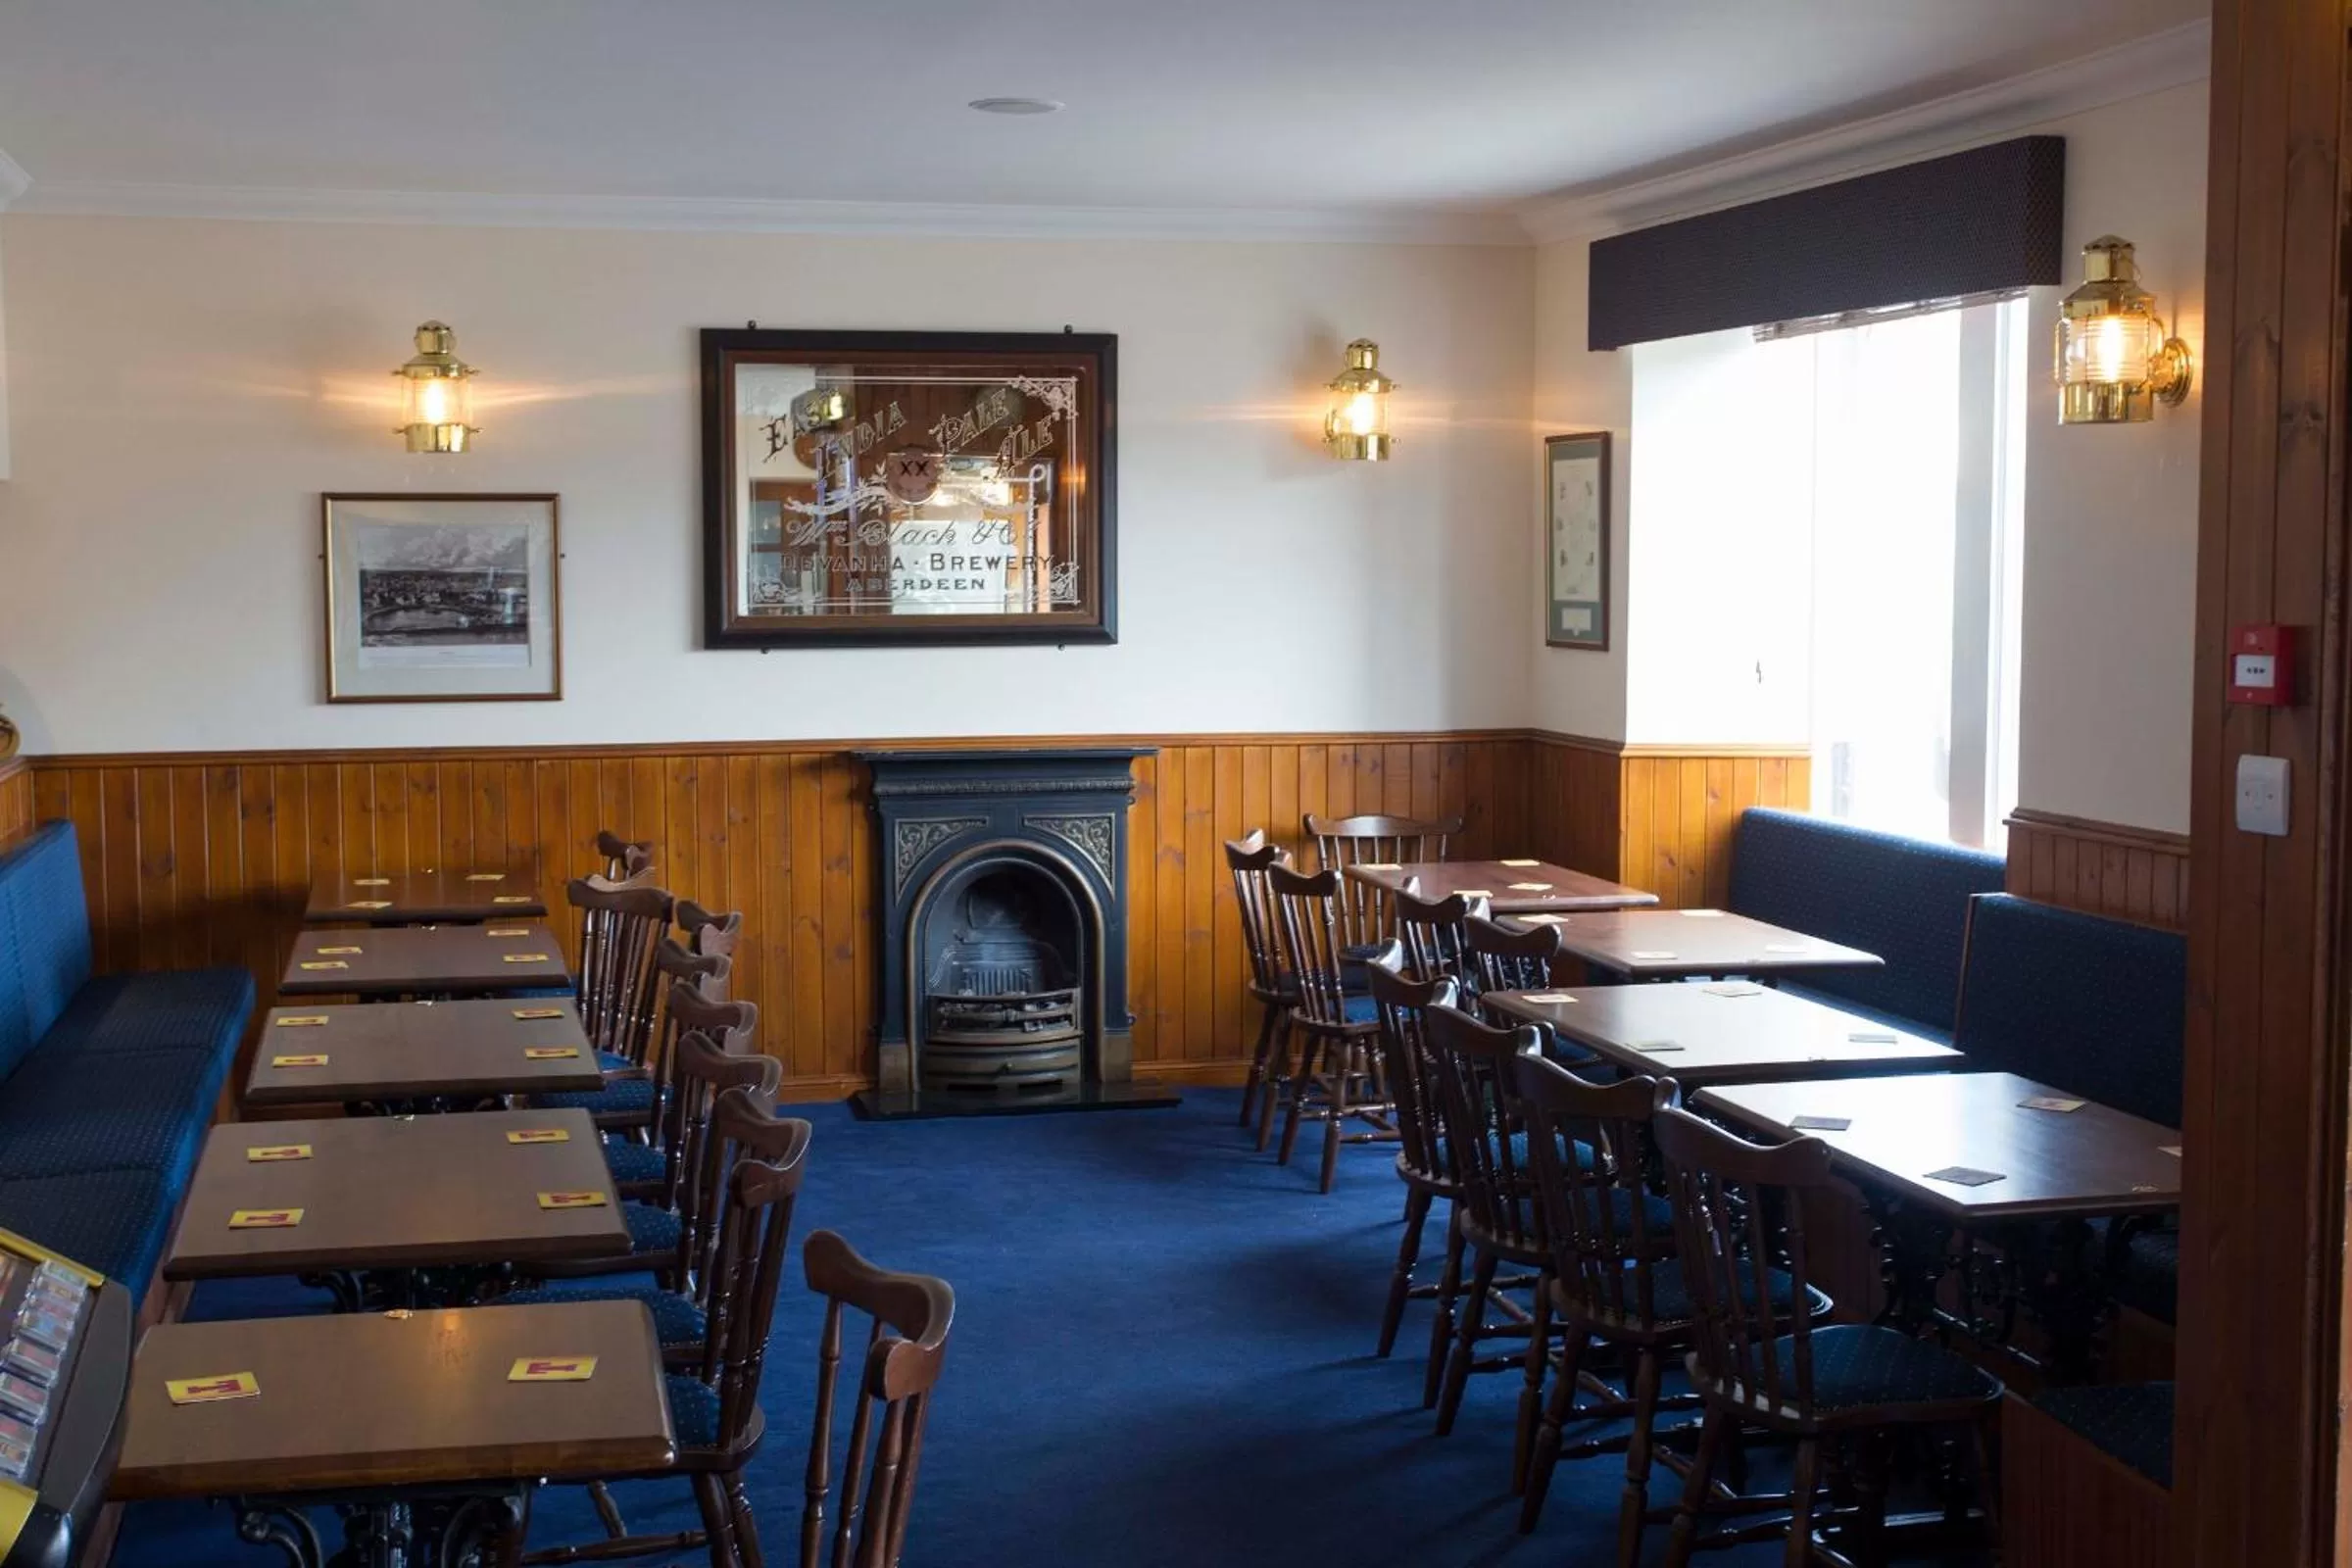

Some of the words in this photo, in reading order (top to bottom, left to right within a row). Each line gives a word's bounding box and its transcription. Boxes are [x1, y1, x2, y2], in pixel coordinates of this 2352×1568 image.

[928, 387, 1009, 458] PALE
[994, 415, 1054, 483] ALE
[900, 461, 929, 477] XX
[833, 519, 956, 546] Black
[930, 553, 1053, 571] BREWERY
[845, 577, 986, 592] ABERDEEN
